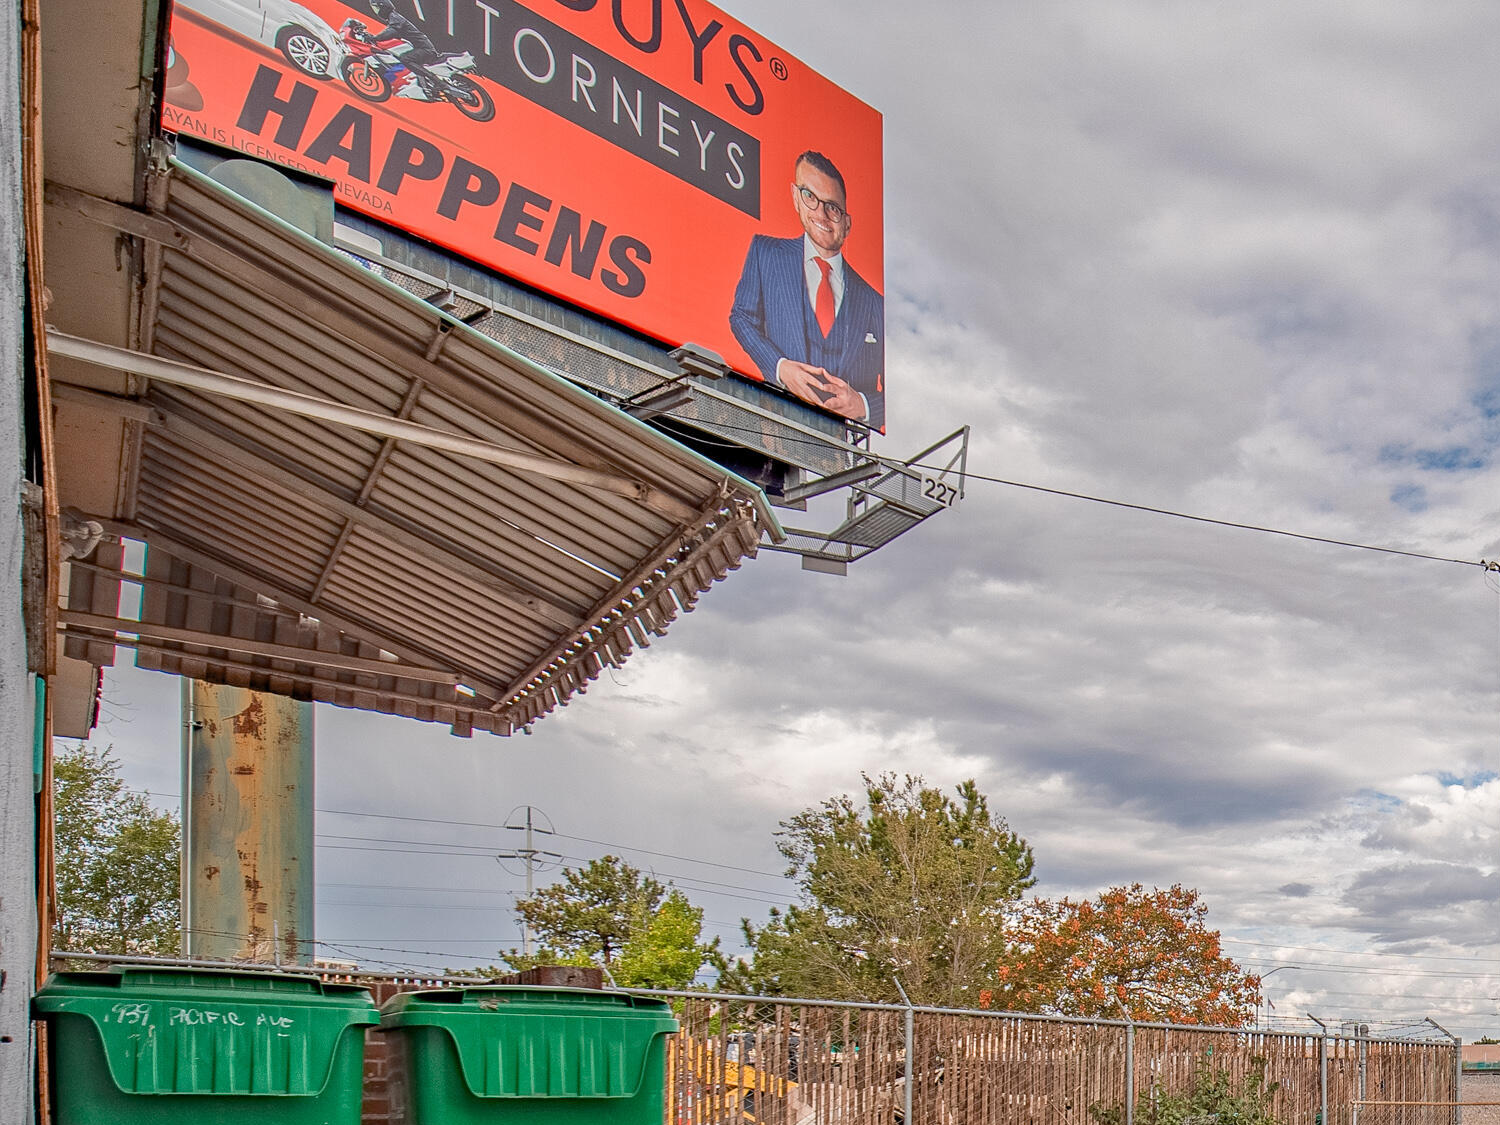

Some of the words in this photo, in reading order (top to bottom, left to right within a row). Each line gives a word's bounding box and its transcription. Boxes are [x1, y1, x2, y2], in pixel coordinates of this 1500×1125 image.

[213, 127, 226, 143] IS
[236, 63, 652, 299] HAPPENS
[924, 478, 957, 506] 227
[257, 1013, 295, 1028] AVE
